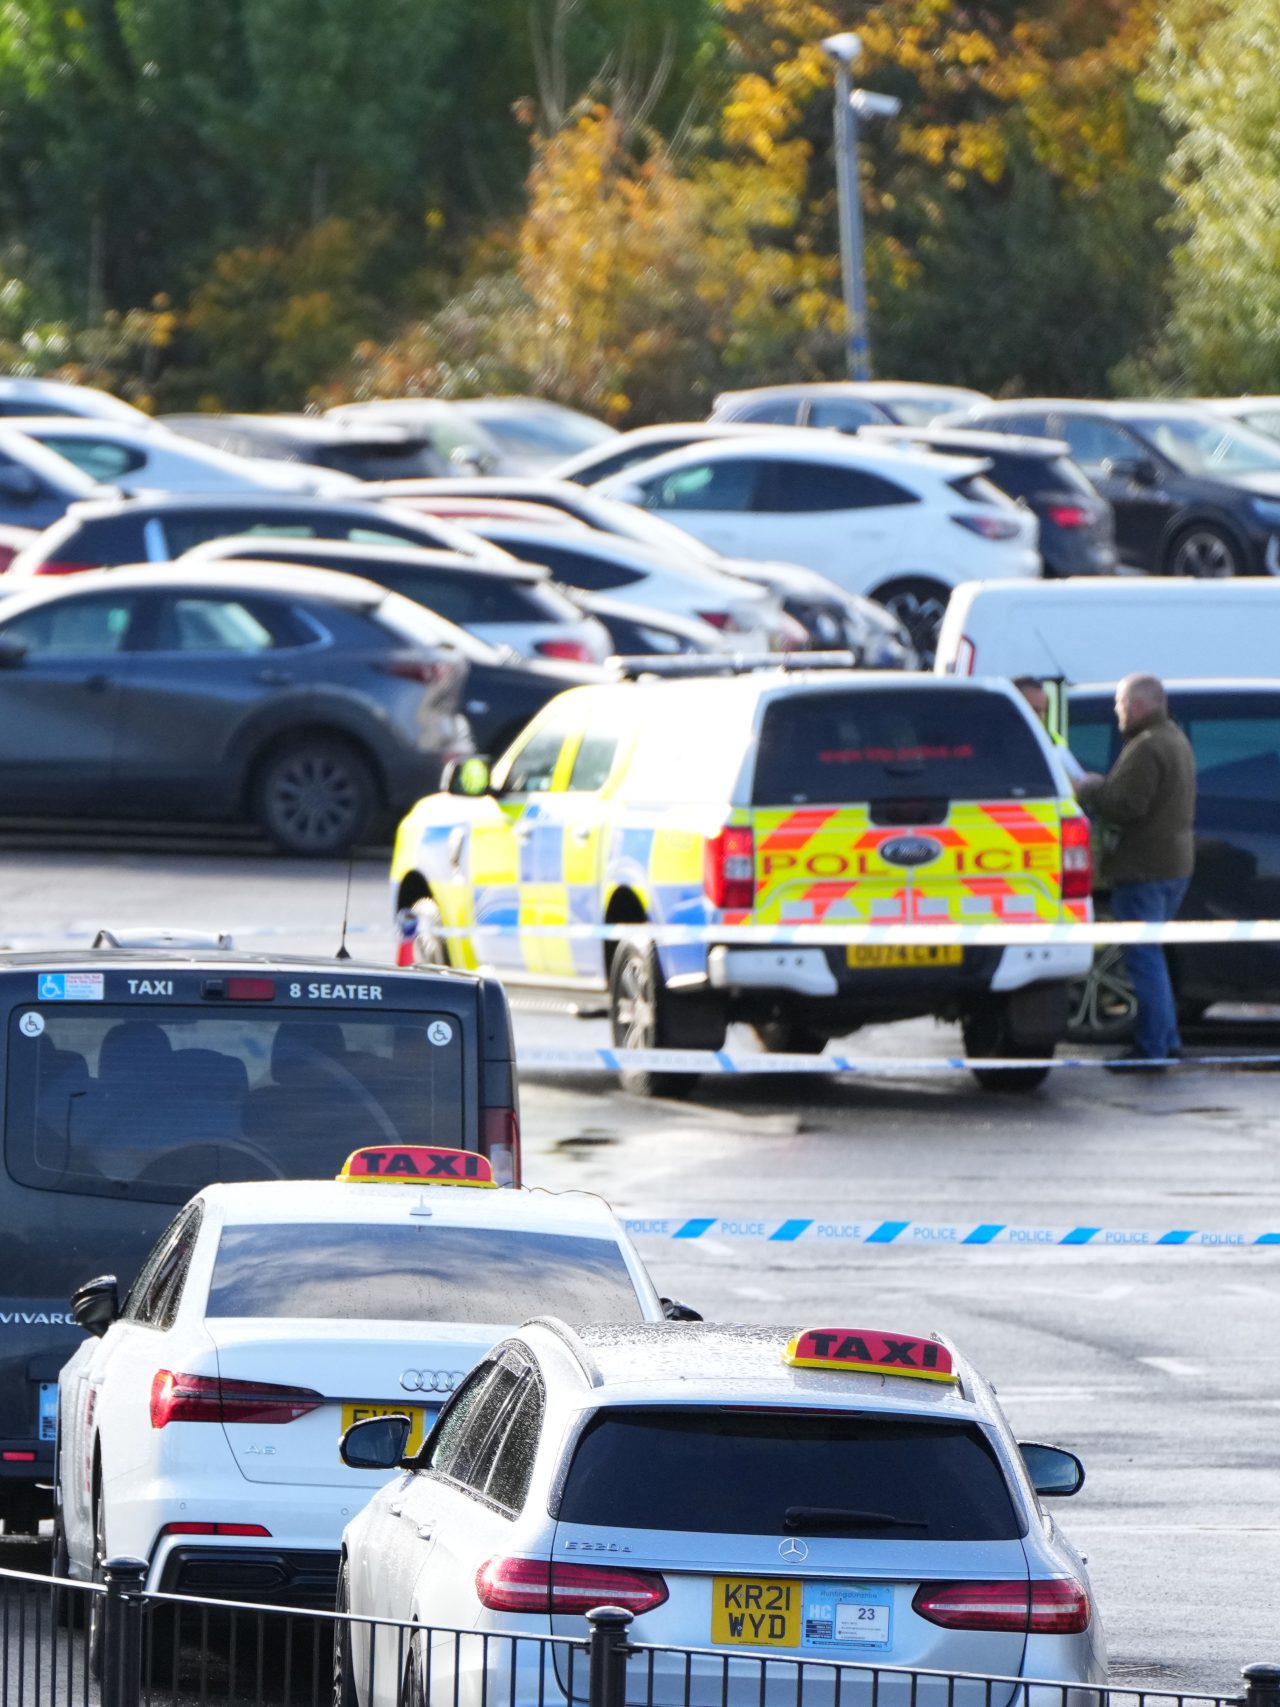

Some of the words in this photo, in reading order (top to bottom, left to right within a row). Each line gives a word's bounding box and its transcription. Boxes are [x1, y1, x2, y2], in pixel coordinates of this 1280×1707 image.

[127, 980, 173, 995] TAXI
[289, 983, 301, 998] 8
[308, 984, 382, 1000] SEATER
[360, 1153, 478, 1176] TAXI
[625, 1220, 668, 1233] POLICE
[721, 1222, 765, 1235] POLICE
[818, 1224, 861, 1238] POLICE
[913, 1227, 957, 1240] POLICE
[1009, 1230, 1053, 1242] POLICE
[1105, 1231, 1149, 1243] POLICE
[1201, 1233, 1244, 1245] POLICE
[809, 1333, 938, 1367] TAXI
[244, 1443, 277, 1455] A6
[724, 1583, 791, 1611] KR21
[809, 1604, 832, 1620] HC
[857, 1607, 876, 1621] 23
[728, 1612, 787, 1639] WYD
